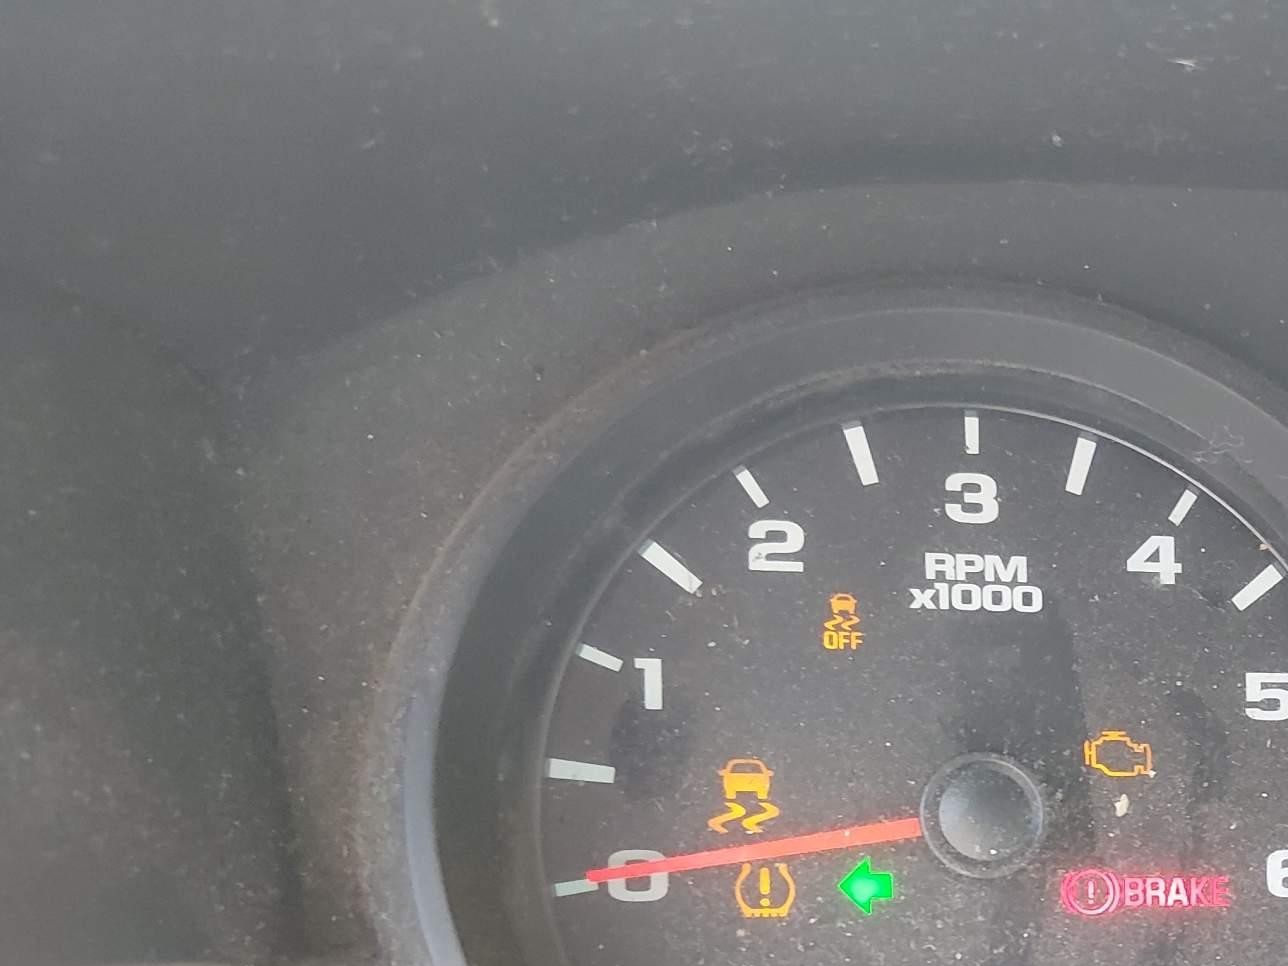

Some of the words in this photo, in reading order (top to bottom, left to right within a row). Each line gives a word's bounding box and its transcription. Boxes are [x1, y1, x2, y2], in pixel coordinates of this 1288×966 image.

[944, 473, 1000, 524] 3
[748, 520, 805, 572] 2
[924, 551, 1028, 584] RPM
[1126, 535, 1183, 585] 4
[909, 583, 1043, 613] x1000
[822, 631, 863, 650] OFF
[633, 658, 663, 710] 1
[607, 849, 669, 902] 0
[1124, 876, 1231, 907] BRAKE
